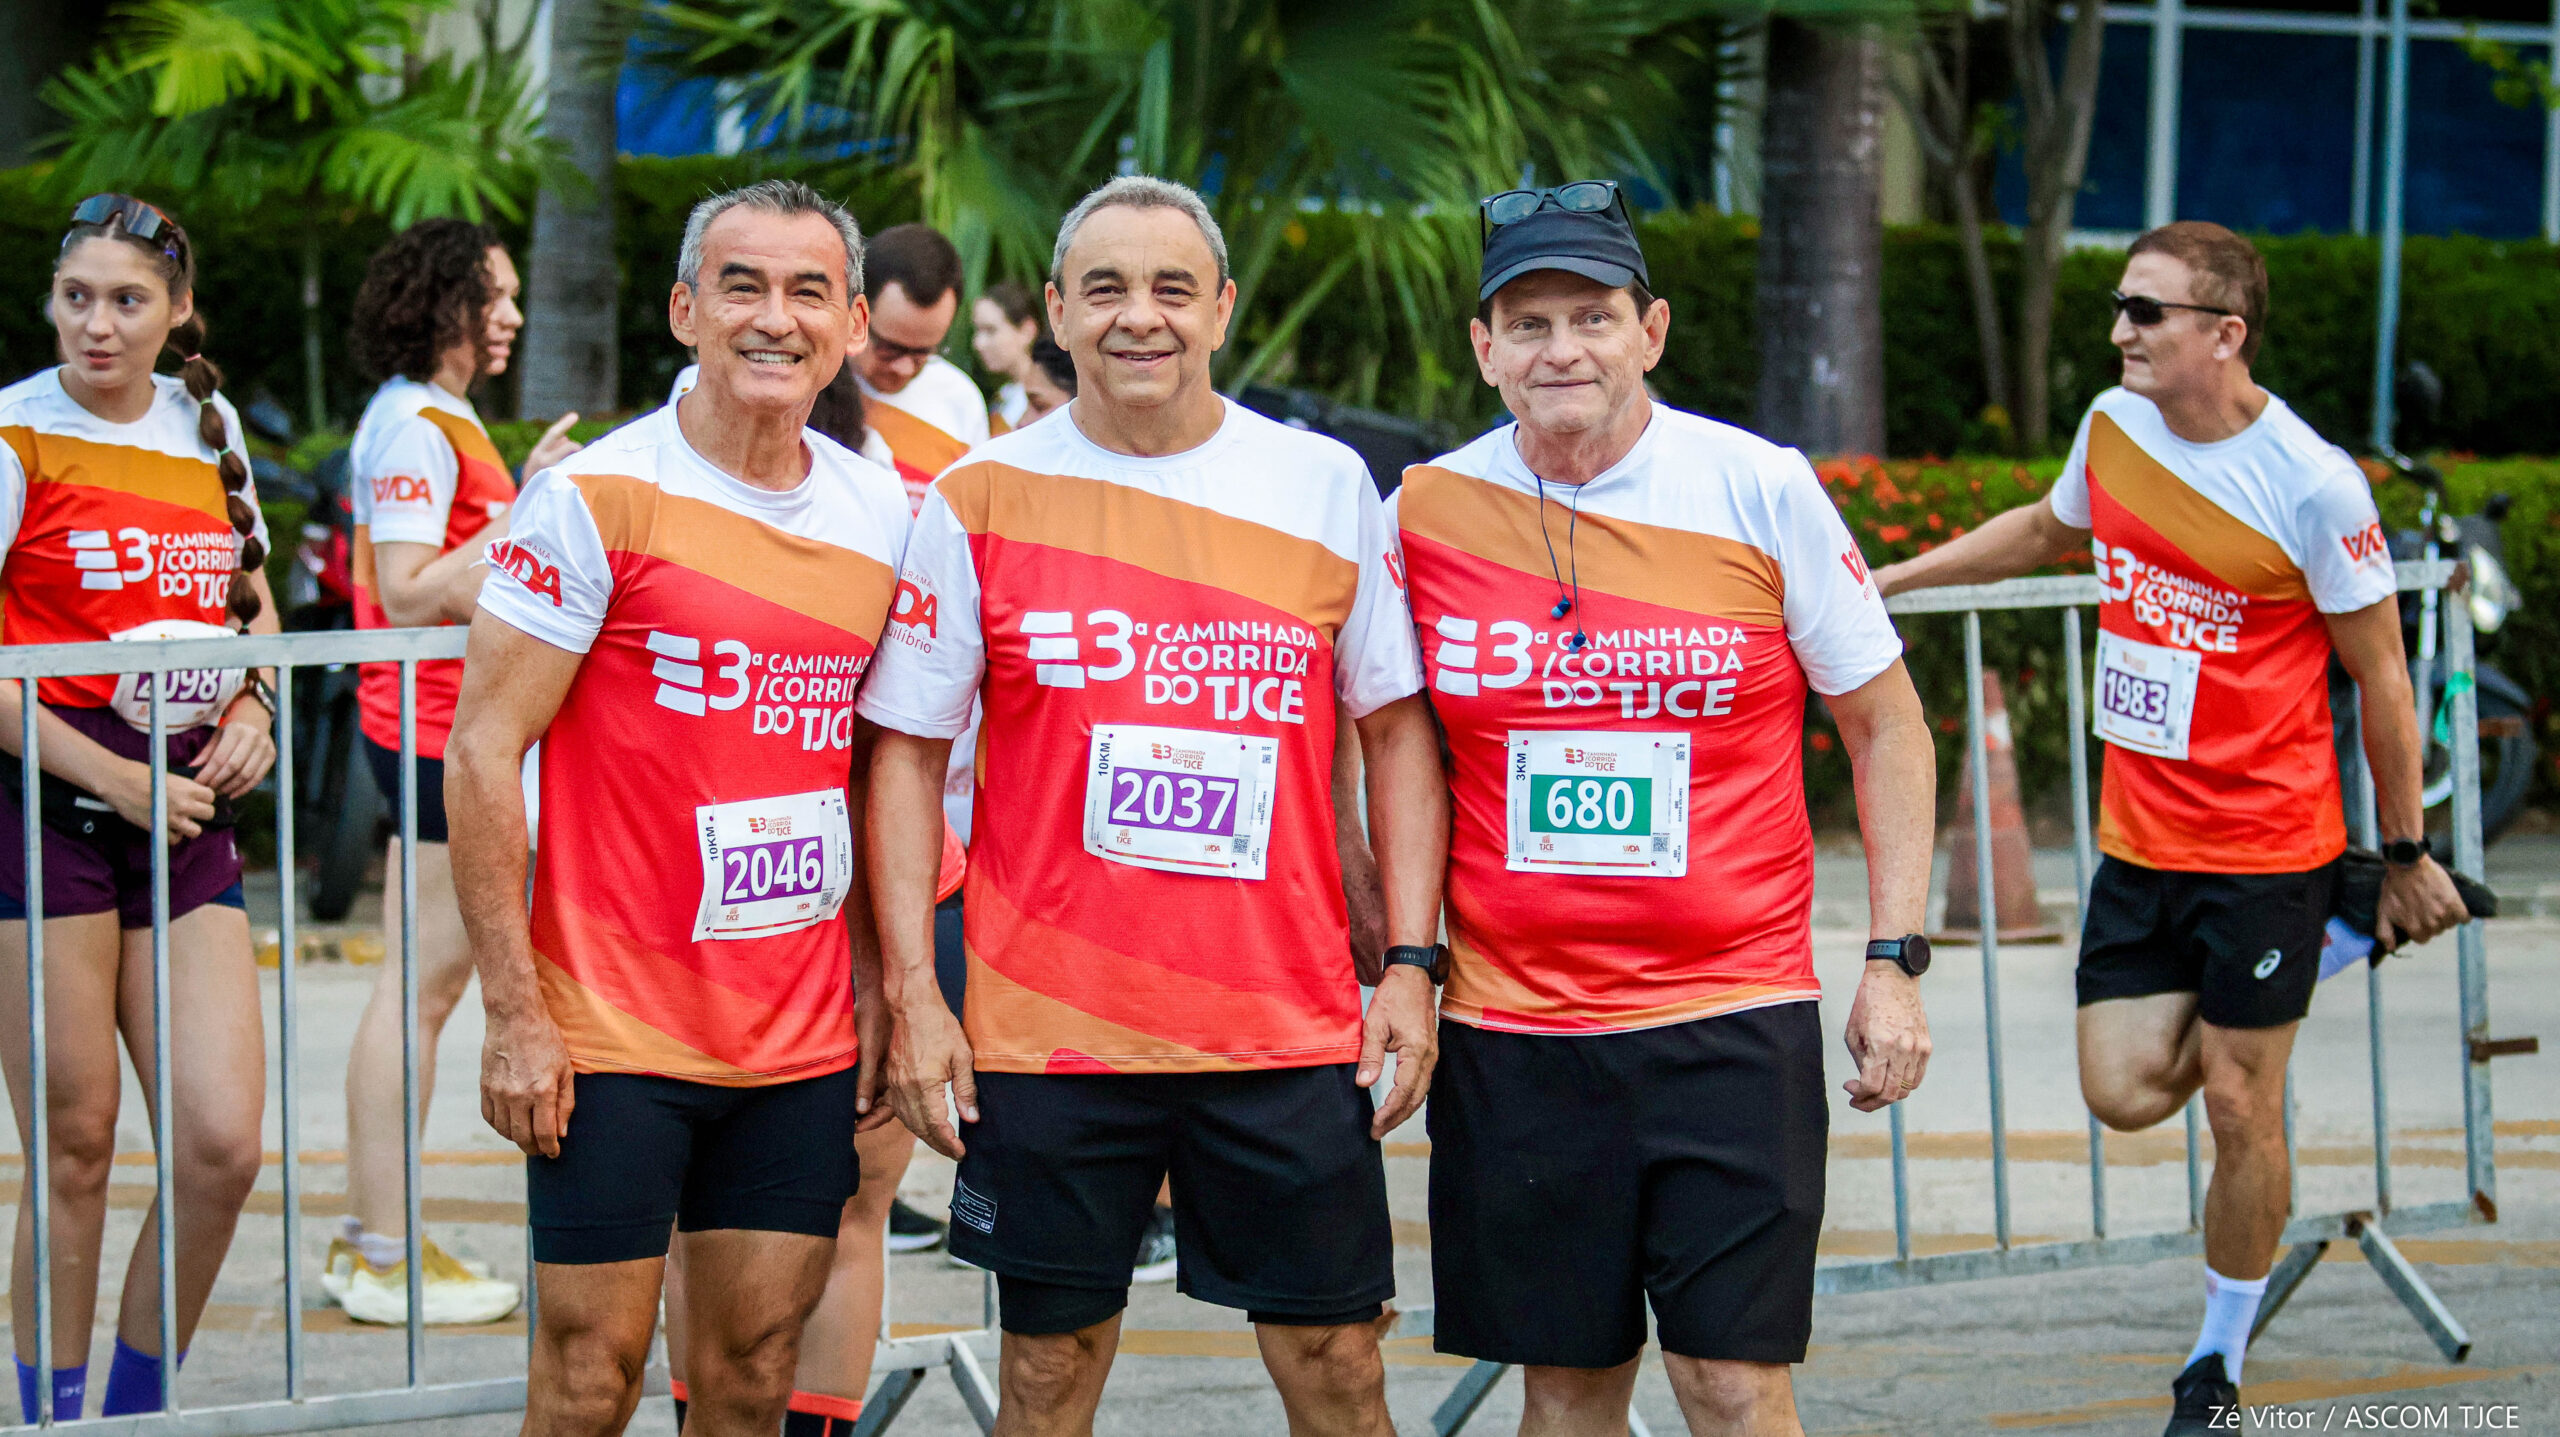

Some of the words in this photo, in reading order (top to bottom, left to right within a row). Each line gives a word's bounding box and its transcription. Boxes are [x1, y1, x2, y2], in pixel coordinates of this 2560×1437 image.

[518, 537, 551, 560] GRAMA
[2342, 523, 2386, 562] VID
[157, 550, 233, 572] /CORRID
[158, 572, 193, 597] DO
[902, 568, 932, 588] GRAMA
[2147, 565, 2248, 607] CAMINHADA
[890, 578, 937, 638] DA
[2134, 579, 2244, 624] /CORRIDA
[885, 625, 932, 653] uilíbrio
[1155, 621, 1317, 650] CAMINHADA
[2133, 599, 2166, 627] DO
[2168, 612, 2238, 653] TJCE
[767, 653, 870, 675] CAMINHAD
[1144, 644, 1308, 676] /CORRIDA
[1542, 648, 1744, 678] /CORRIDA
[755, 674, 859, 702] /CORRID
[1145, 674, 1199, 705] DO
[1205, 676, 1304, 724] TJCE
[1543, 680, 1603, 708] DO
[1609, 678, 1737, 719] TJCE
[2107, 672, 2167, 722] 1983
[753, 704, 795, 735] DO
[1098, 742, 1110, 776] 10KM
[1183, 760, 1202, 770] TJCE
[1516, 753, 1526, 781] 3KM
[1595, 763, 1615, 771] TJCE
[1112, 771, 1236, 830] 2037
[1546, 779, 1634, 830] 680
[705, 826, 719, 862] 10KM
[776, 826, 791, 836] TJCE
[1116, 836, 1132, 845] TJCE
[724, 840, 822, 901] 2046
